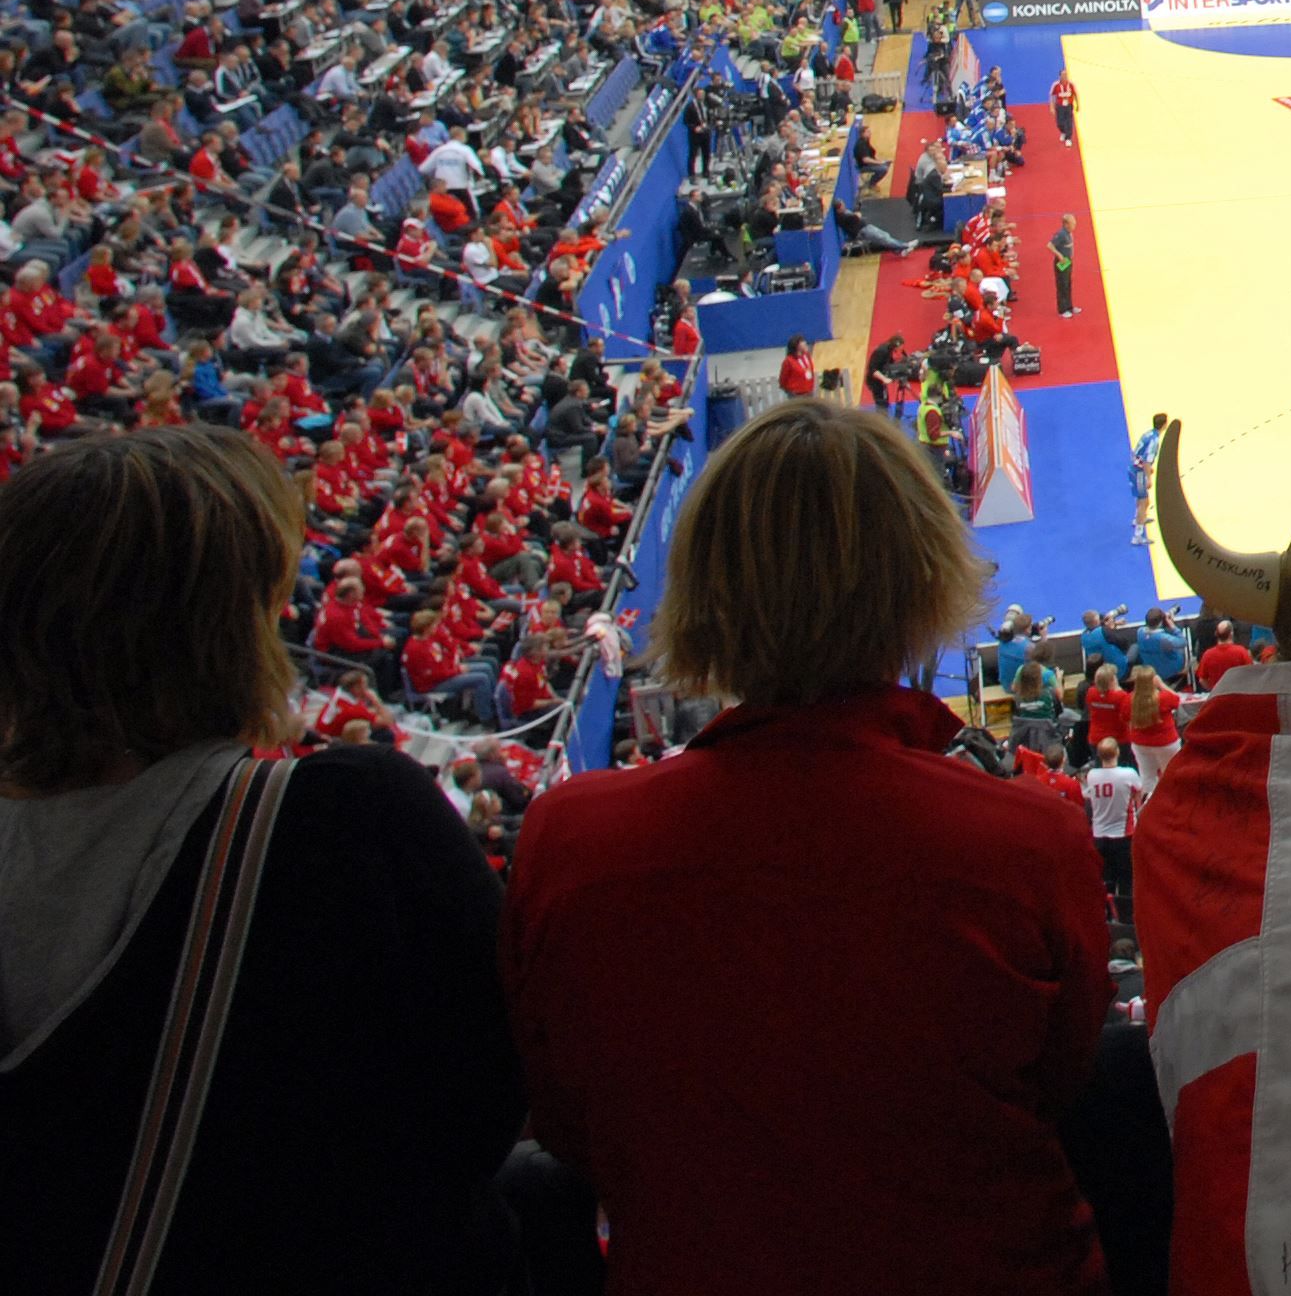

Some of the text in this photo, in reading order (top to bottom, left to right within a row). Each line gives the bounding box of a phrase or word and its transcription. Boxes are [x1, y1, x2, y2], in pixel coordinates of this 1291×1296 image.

[1013, 0, 1139, 18] KONICA MINOLTA
[1094, 783, 1113, 798] 10
